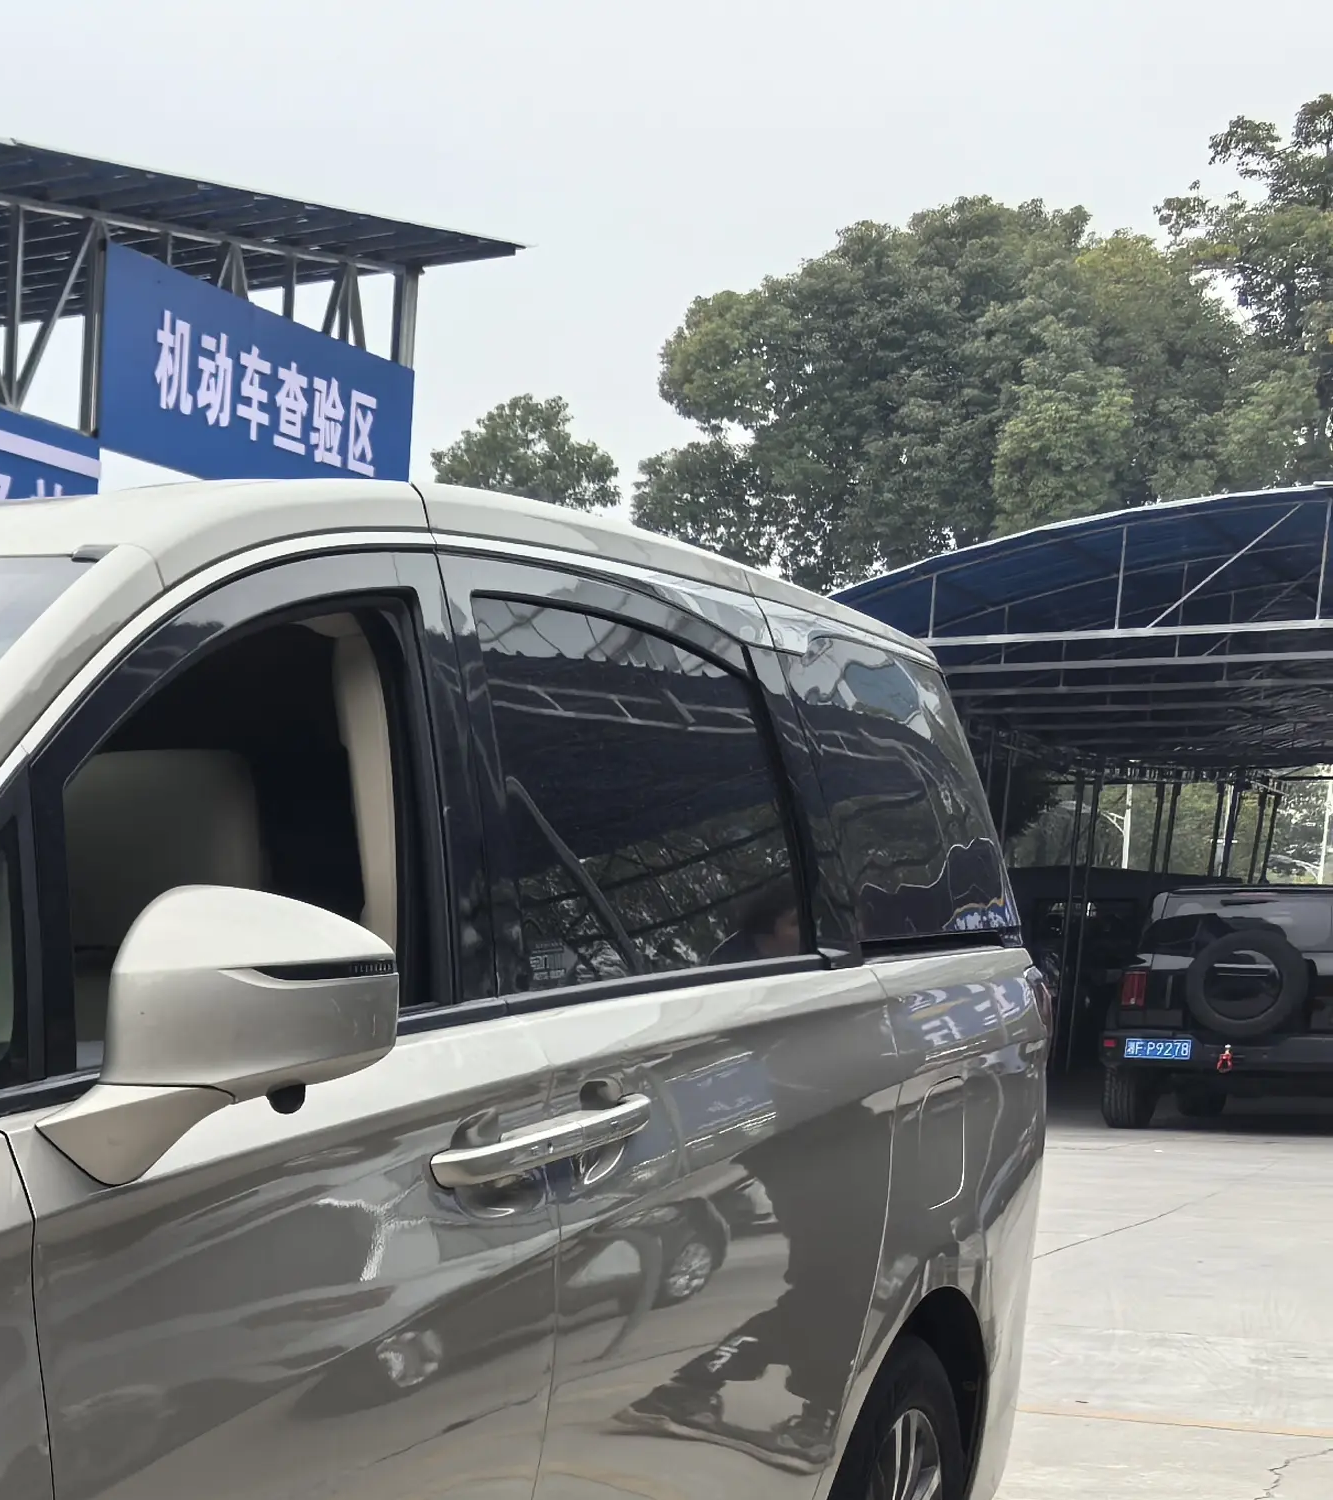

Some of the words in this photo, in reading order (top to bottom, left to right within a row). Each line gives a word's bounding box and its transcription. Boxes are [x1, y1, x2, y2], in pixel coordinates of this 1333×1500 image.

[154, 310, 376, 477] 机动车查验区
